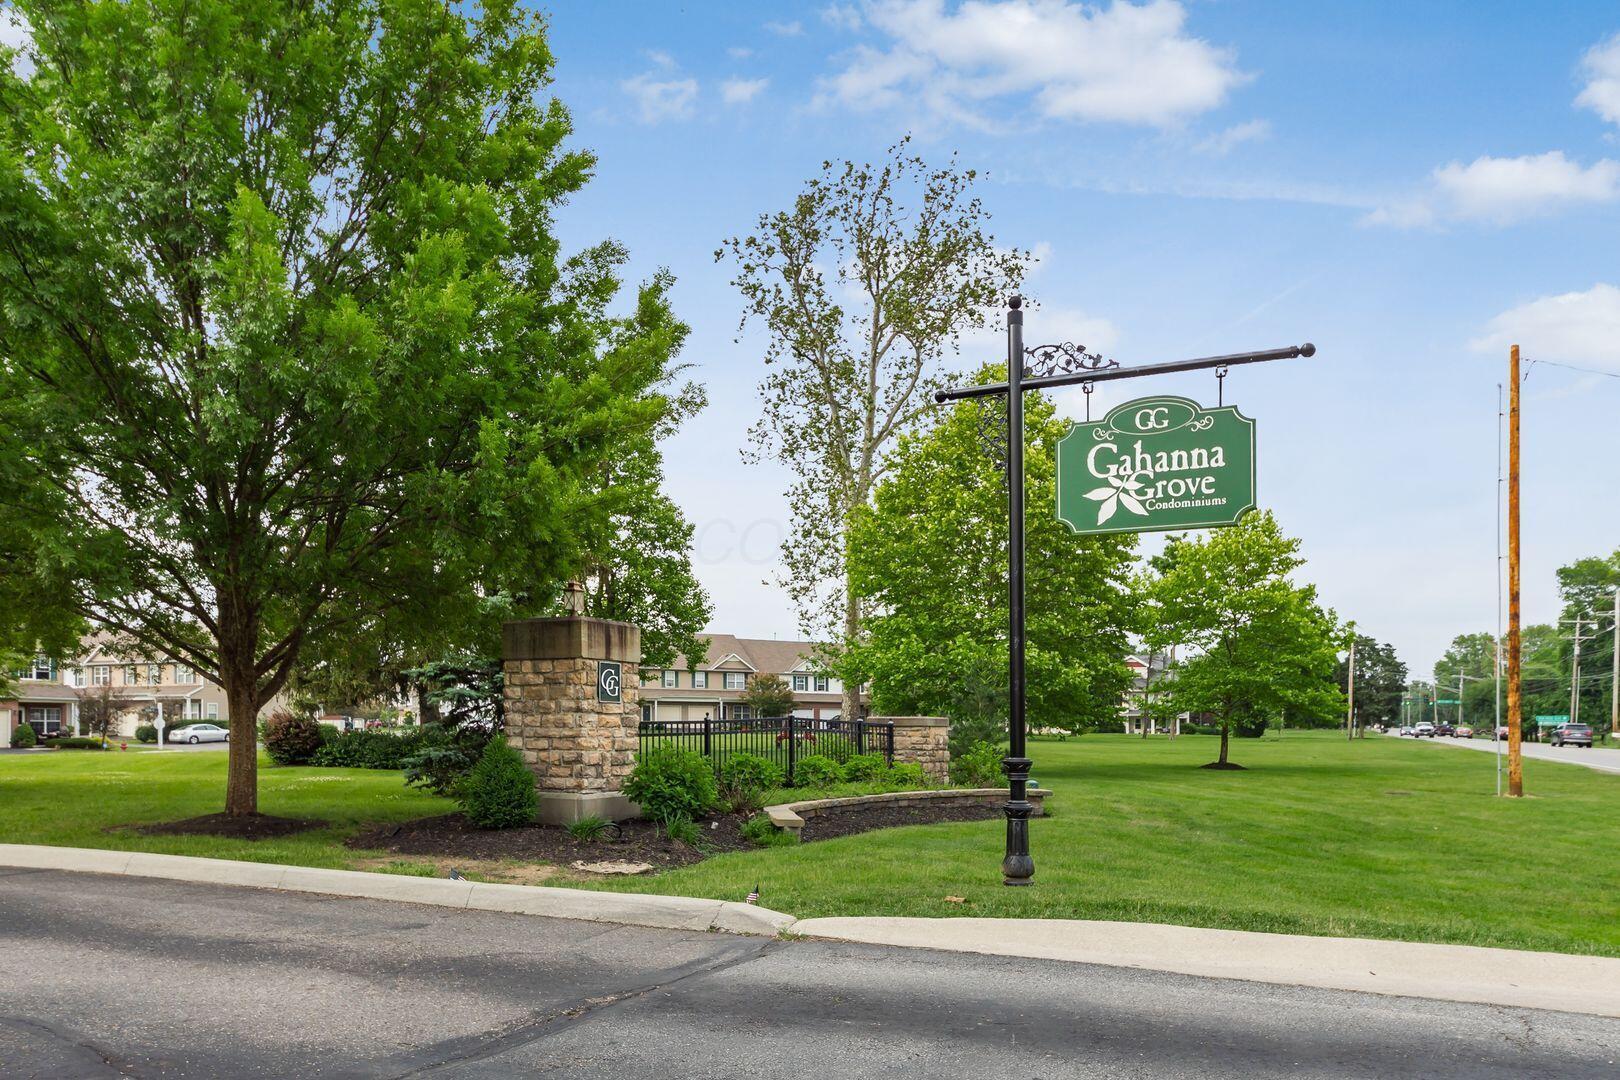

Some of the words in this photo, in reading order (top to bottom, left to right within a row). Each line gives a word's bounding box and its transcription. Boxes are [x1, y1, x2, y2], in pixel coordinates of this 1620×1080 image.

[1134, 407, 1169, 430] GG
[1086, 440, 1226, 479] Gahanna
[1125, 469, 1216, 500] Grove
[1145, 496, 1227, 511] Condominiums
